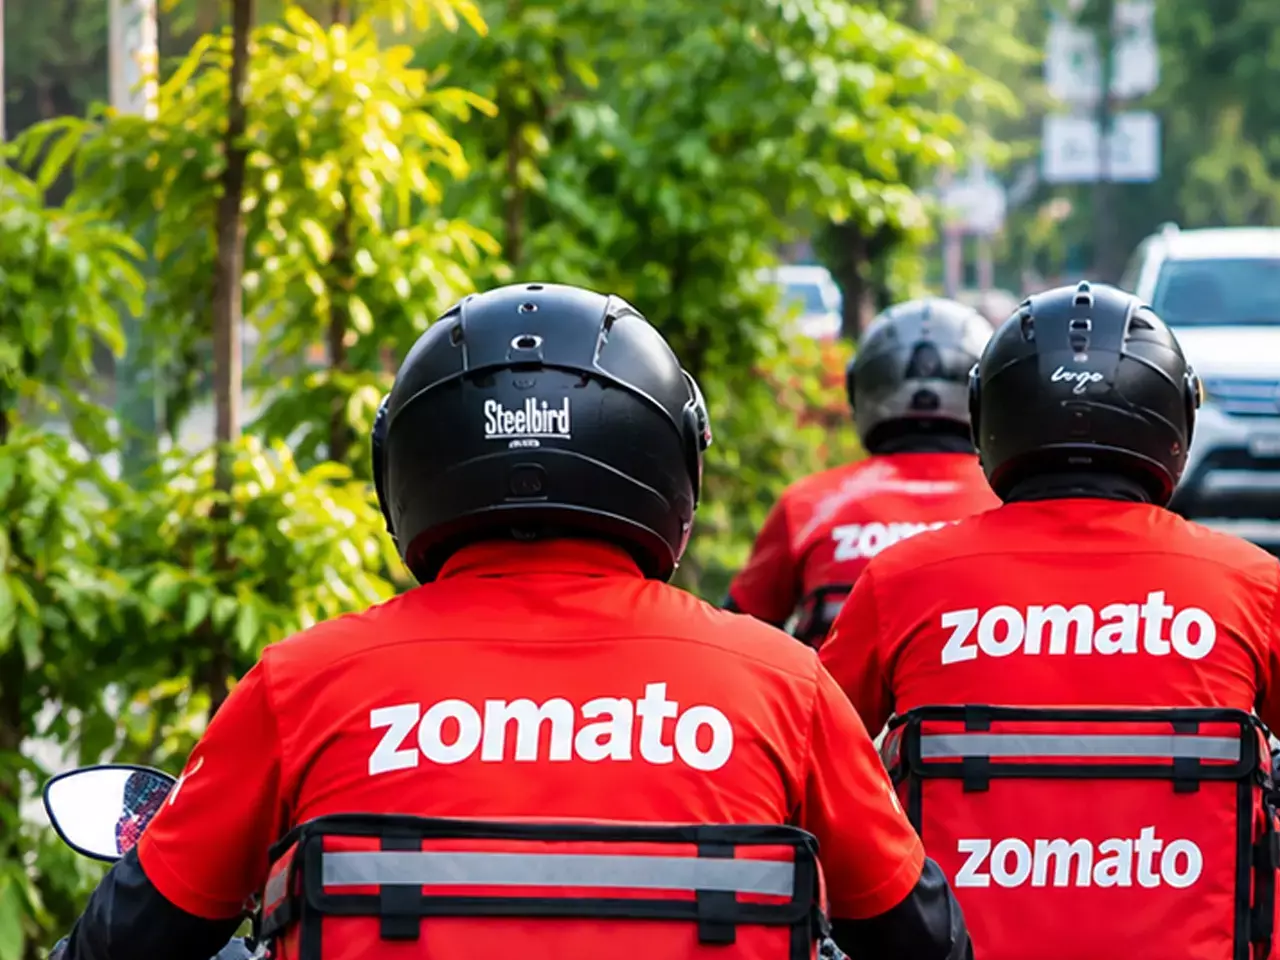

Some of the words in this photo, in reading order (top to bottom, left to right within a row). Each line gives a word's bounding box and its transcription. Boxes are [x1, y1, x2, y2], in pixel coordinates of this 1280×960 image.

[484, 397, 570, 434] Steelbird
[941, 590, 1217, 665] zomato
[368, 682, 734, 776] zomato
[955, 826, 1203, 888] zomato
